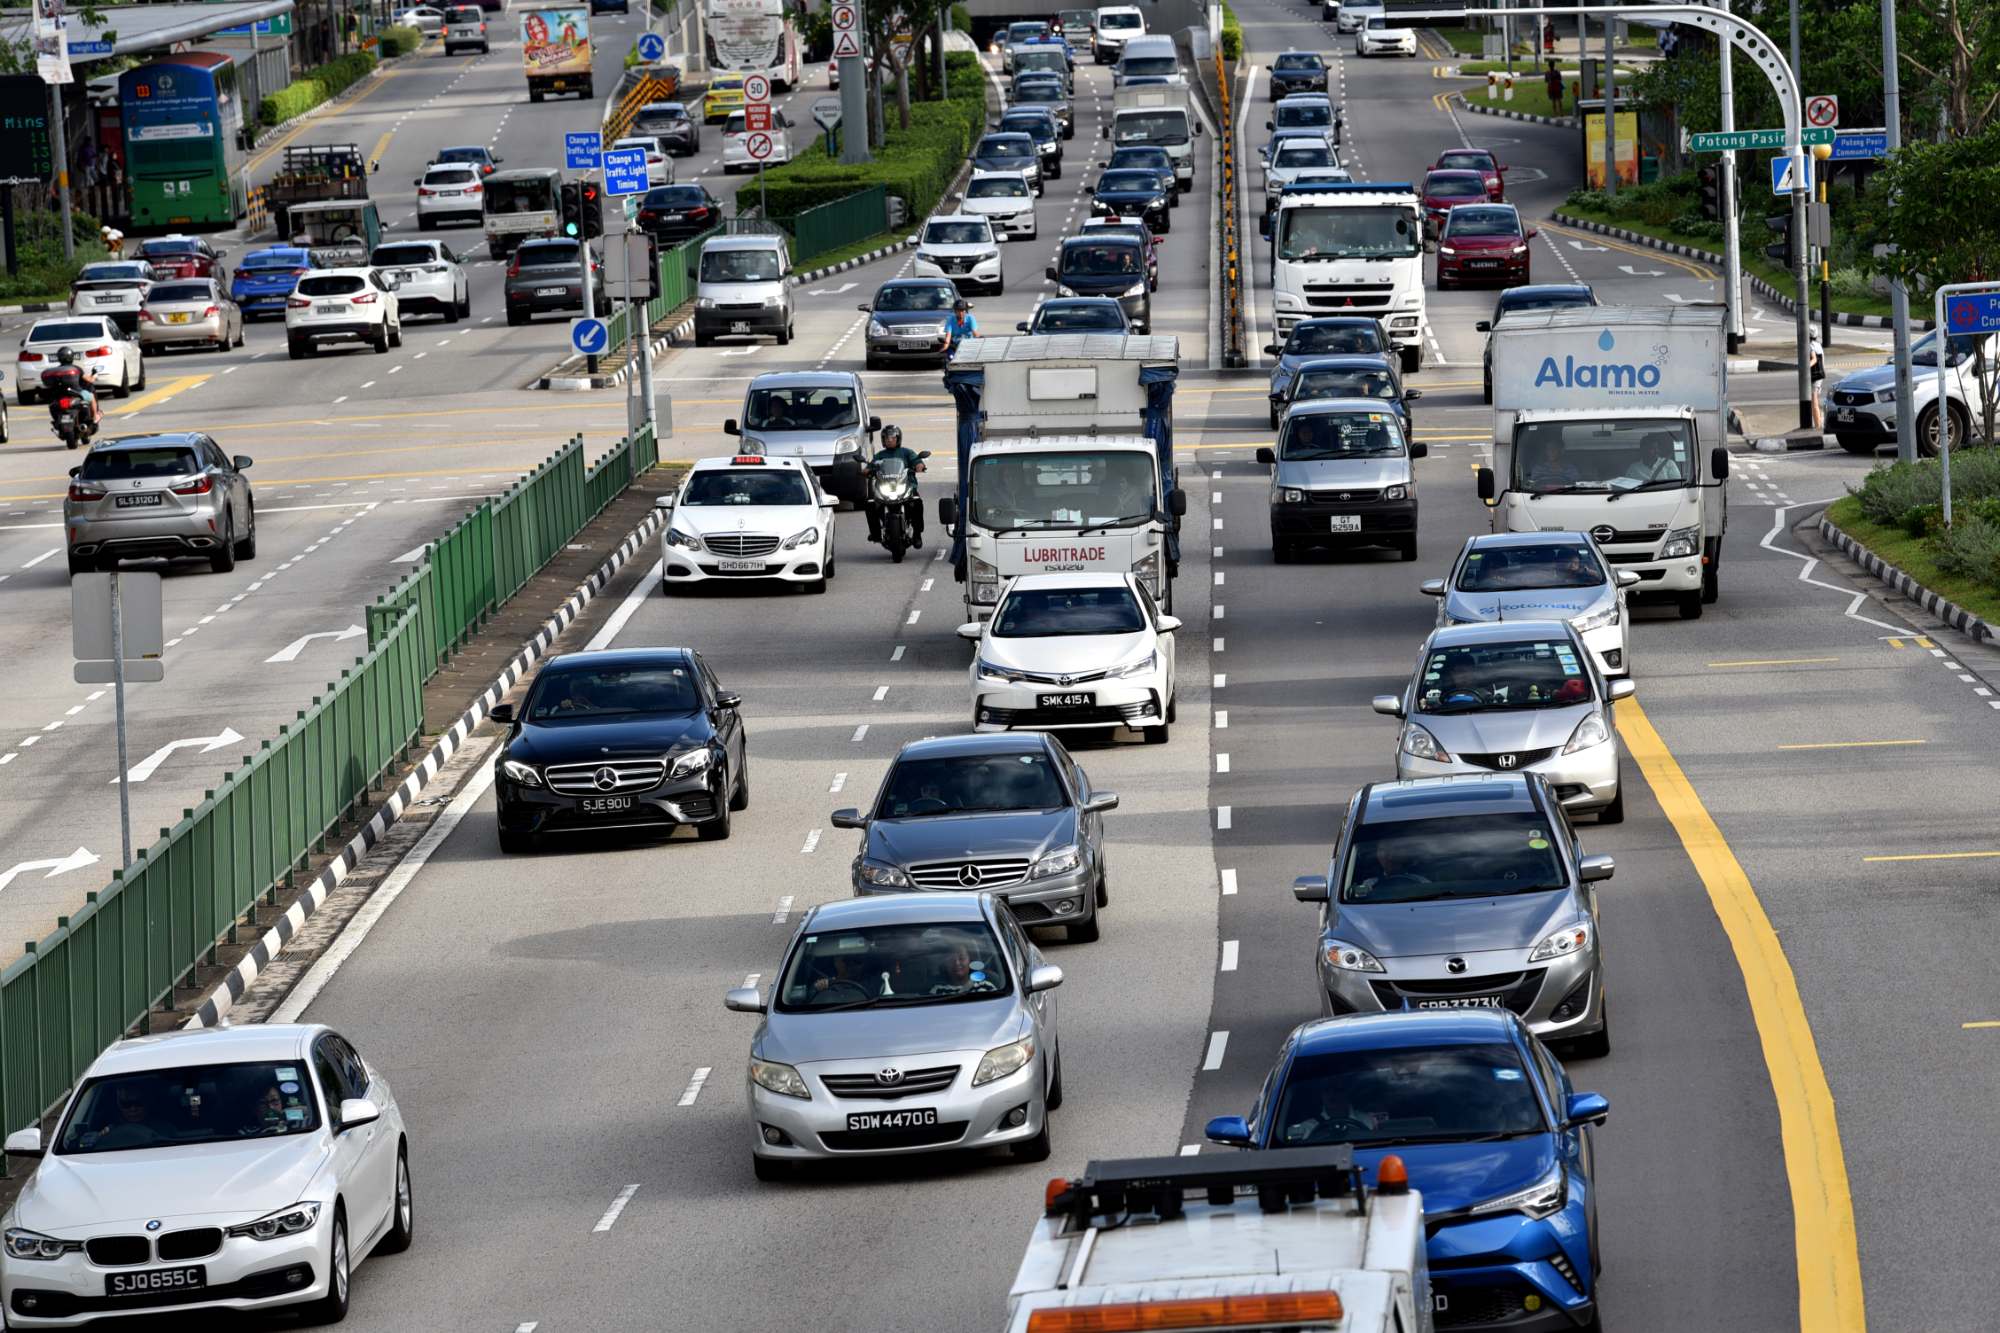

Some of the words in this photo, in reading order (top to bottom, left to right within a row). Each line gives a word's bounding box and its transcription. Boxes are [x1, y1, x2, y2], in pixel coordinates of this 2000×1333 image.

[751, 83, 763, 94] 50
[4, 117, 45, 129] Mins
[569, 136, 589, 145] Change
[1698, 134, 1746, 150] Potong
[1751, 131, 1785, 144] Pasir
[1823, 129, 1828, 140] 1
[1841, 138, 1863, 148] Potong
[1866, 137, 1884, 145] Pasir
[1837, 148, 1873, 157] Community
[608, 155, 632, 165] Change
[606, 167, 627, 177] Traffic
[629, 165, 646, 176] Light
[616, 180, 639, 190] Timing
[1534, 355, 1661, 388] Alamo
[1024, 547, 1105, 562] LUBRITRADE
[1045, 564, 1084, 572] ISUZU
